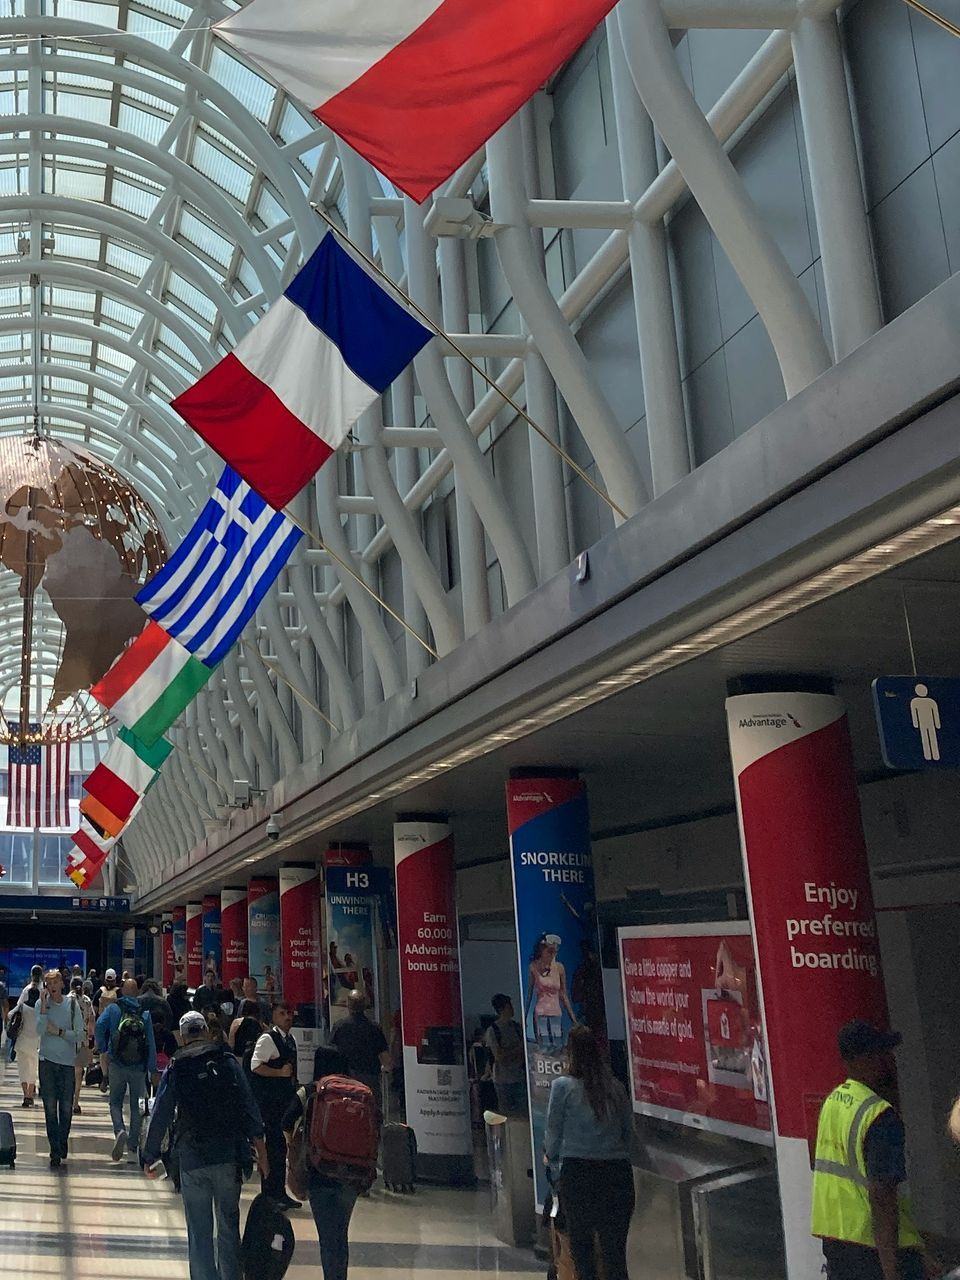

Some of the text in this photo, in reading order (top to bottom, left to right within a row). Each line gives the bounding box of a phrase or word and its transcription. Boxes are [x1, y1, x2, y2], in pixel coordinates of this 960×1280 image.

[346, 872, 369, 888] H3
[542, 868, 585, 884] THERE
[804, 882, 858, 910] Enjoy
[423, 911, 447, 923] Earn
[786, 914, 874, 940] preferred
[407, 959, 438, 972] bonus
[624, 957, 637, 977] Give
[642, 957, 656, 977] little
[656, 962, 678, 981] copper
[679, 959, 692, 978] and
[630, 985, 689, 1012] show the world your
[653, 1017, 670, 1037] made
[670, 1017, 678, 1038] of
